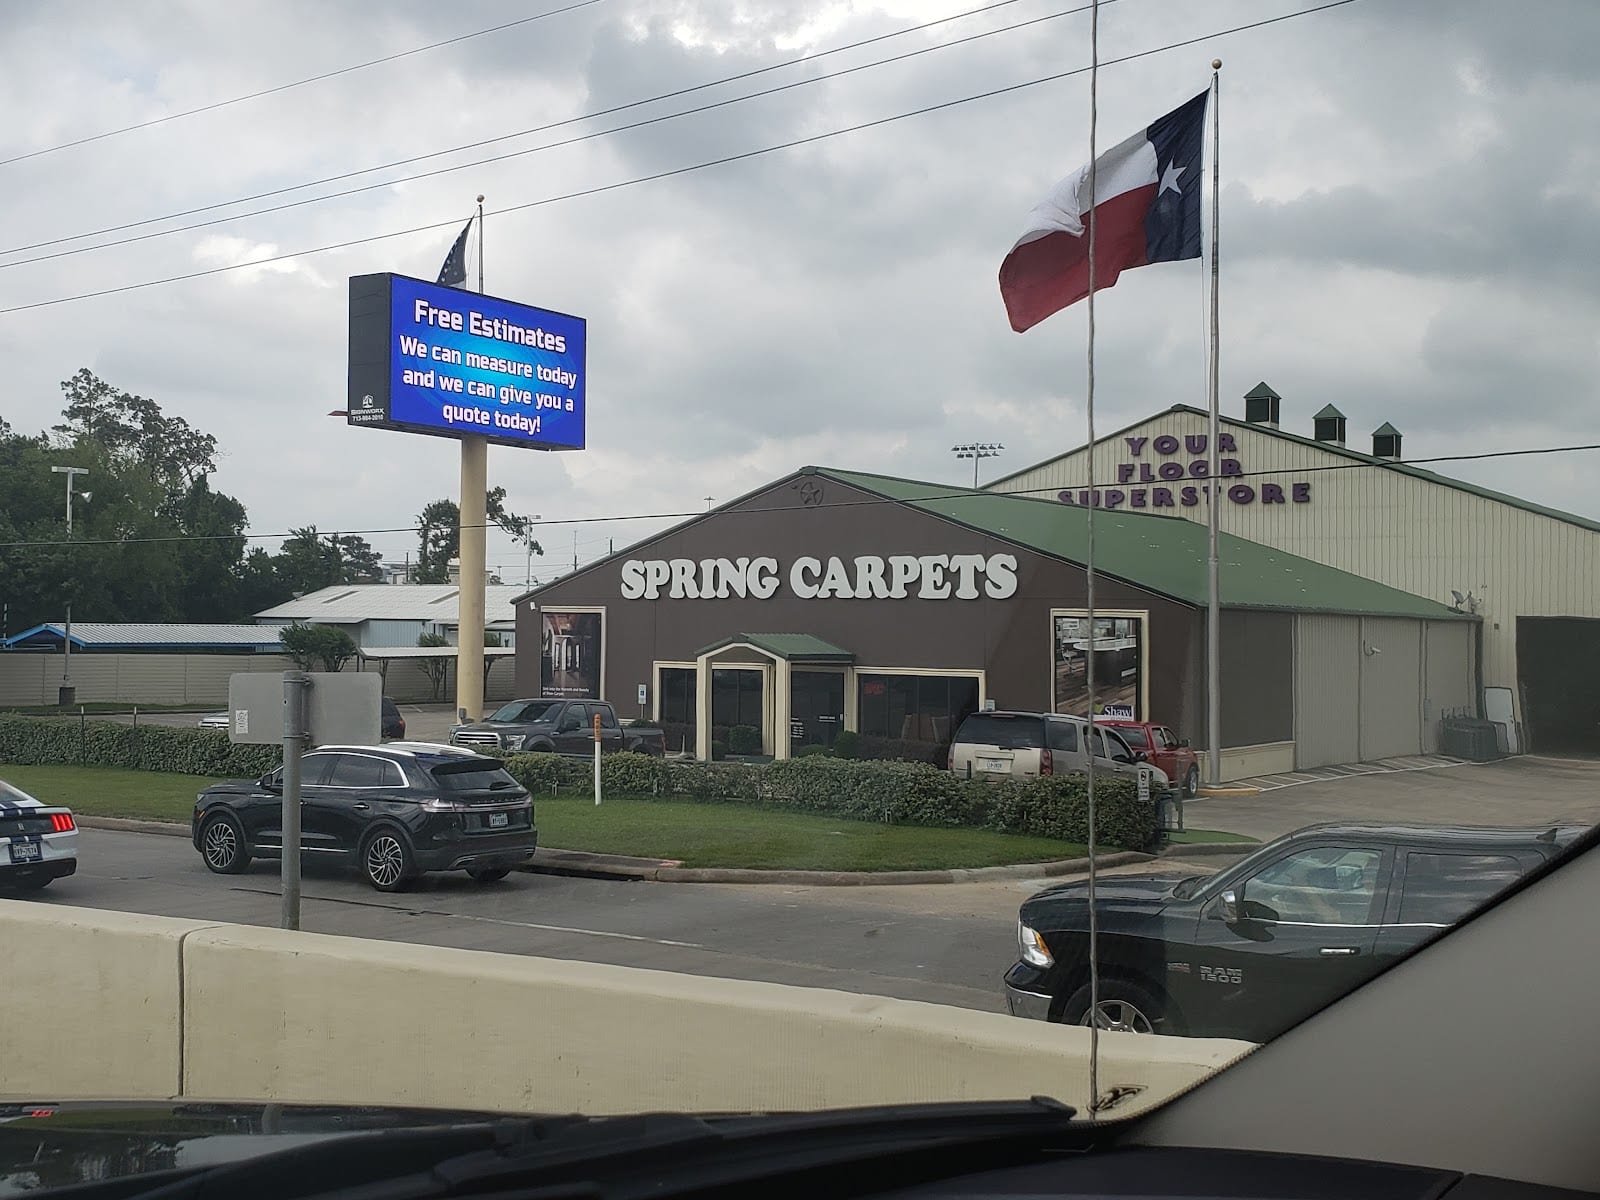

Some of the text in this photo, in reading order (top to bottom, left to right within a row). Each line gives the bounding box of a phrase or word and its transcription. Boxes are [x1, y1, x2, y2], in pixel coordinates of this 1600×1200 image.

[414, 299, 567, 354] Free Estimates
[399, 335, 577, 389] We can measure today
[403, 368, 574, 412] and we can give you a
[442, 404, 541, 435] quote today!
[1125, 433, 1237, 456] YOUR
[1118, 459, 1242, 482] FLOOR
[620, 554, 1018, 600] SPRING CARPETS
[1104, 706, 1131, 718] Shaw
[1199, 965, 1243, 977] RAM
[1200, 973, 1242, 984] 1500
